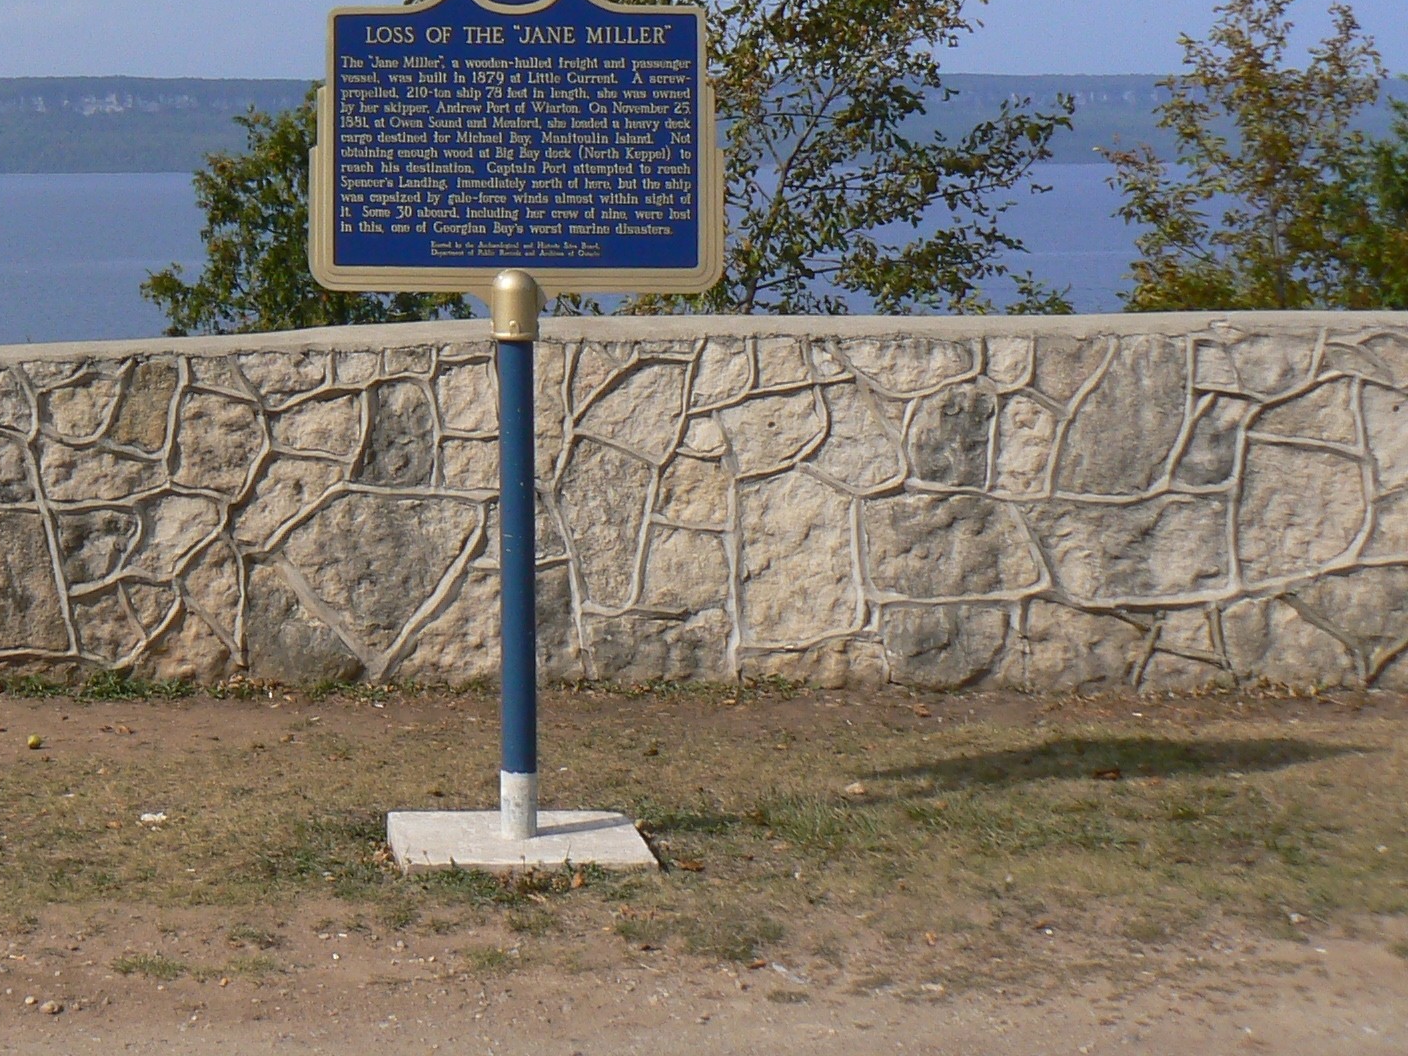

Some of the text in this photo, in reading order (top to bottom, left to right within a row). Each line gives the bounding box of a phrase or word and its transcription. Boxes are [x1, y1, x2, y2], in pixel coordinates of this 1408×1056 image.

[366, 25, 671, 43] LOSS OF THE "JANE MILLER"
[341, 56, 363, 69] The
[452, 59, 459, 69] a
[465, 56, 552, 69] wooden-hulled
[559, 57, 598, 72] freight
[603, 57, 625, 70] and
[632, 60, 691, 72] passenger
[388, 74, 412, 84] was
[419, 71, 447, 84] built
[454, 71, 465, 84] in
[472, 71, 504, 85] 1879
[510, 71, 521, 84] at
[528, 72, 561, 85] Little
[632, 72, 642, 85] A
[649, 75, 691, 85] screw-
[407, 86, 451, 99] 210-ton
[457, 86, 481, 101] ship
[486, 86, 502, 99] 78
[507, 86, 527, 99] feet
[533, 87, 544, 100] in
[597, 87, 618, 100] she
[623, 90, 646, 100] was
[653, 87, 690, 100] owned
[340, 101, 355, 116] by
[359, 101, 379, 114] her
[436, 101, 482, 114] Andrew
[487, 101, 510, 114] Port
[515, 102, 525, 115] of
[589, 102, 608, 115] On
[613, 102, 669, 115] November
[374, 116, 385, 129] at
[390, 116, 423, 129] Owen
[428, 116, 462, 129] Sound
[467, 116, 487, 129] and
[548, 117, 566, 130] she
[571, 117, 607, 130] loaded
[612, 120, 619, 130] a
[625, 117, 660, 132] heavy
[665, 117, 690, 130] deck
[341, 134, 372, 146] cargo
[377, 131, 427, 144] destined
[433, 131, 451, 144] for
[456, 131, 502, 144] Michael
[541, 132, 608, 145] Manitoulin
[671, 132, 690, 145] Not
[341, 146, 691, 162] obtaining enough wood at Big Bay dock (North Keppel) to
[341, 161, 374, 174] reach
[381, 161, 400, 174] his
[487, 161, 536, 176] Captain
[542, 162, 566, 175] Port
[574, 162, 632, 177] attempted
[639, 162, 651, 175] to
[658, 162, 690, 175] reach
[341, 176, 393, 191] Spencer's
[457, 176, 526, 191] immediately
[532, 177, 562, 190] north
[568, 177, 578, 190] of
[619, 177, 636, 190] but
[642, 177, 660, 190] the
[665, 177, 691, 192] ship
[341, 191, 691, 207] was capsized by gale-force winds almost within sight of
[362, 206, 391, 219] Some
[396, 206, 412, 219] 30
[466, 206, 519, 221] including
[526, 207, 546, 220] her
[551, 210, 579, 220] crew
[585, 207, 594, 220] of
[635, 210, 663, 220] were
[669, 207, 690, 220] lost
[341, 221, 352, 234] in
[391, 224, 410, 234] one
[416, 221, 426, 234] of
[433, 221, 486, 236] Georgian
[493, 221, 524, 236] Bay's
[529, 222, 562, 235] worst
[569, 222, 610, 235] marine
